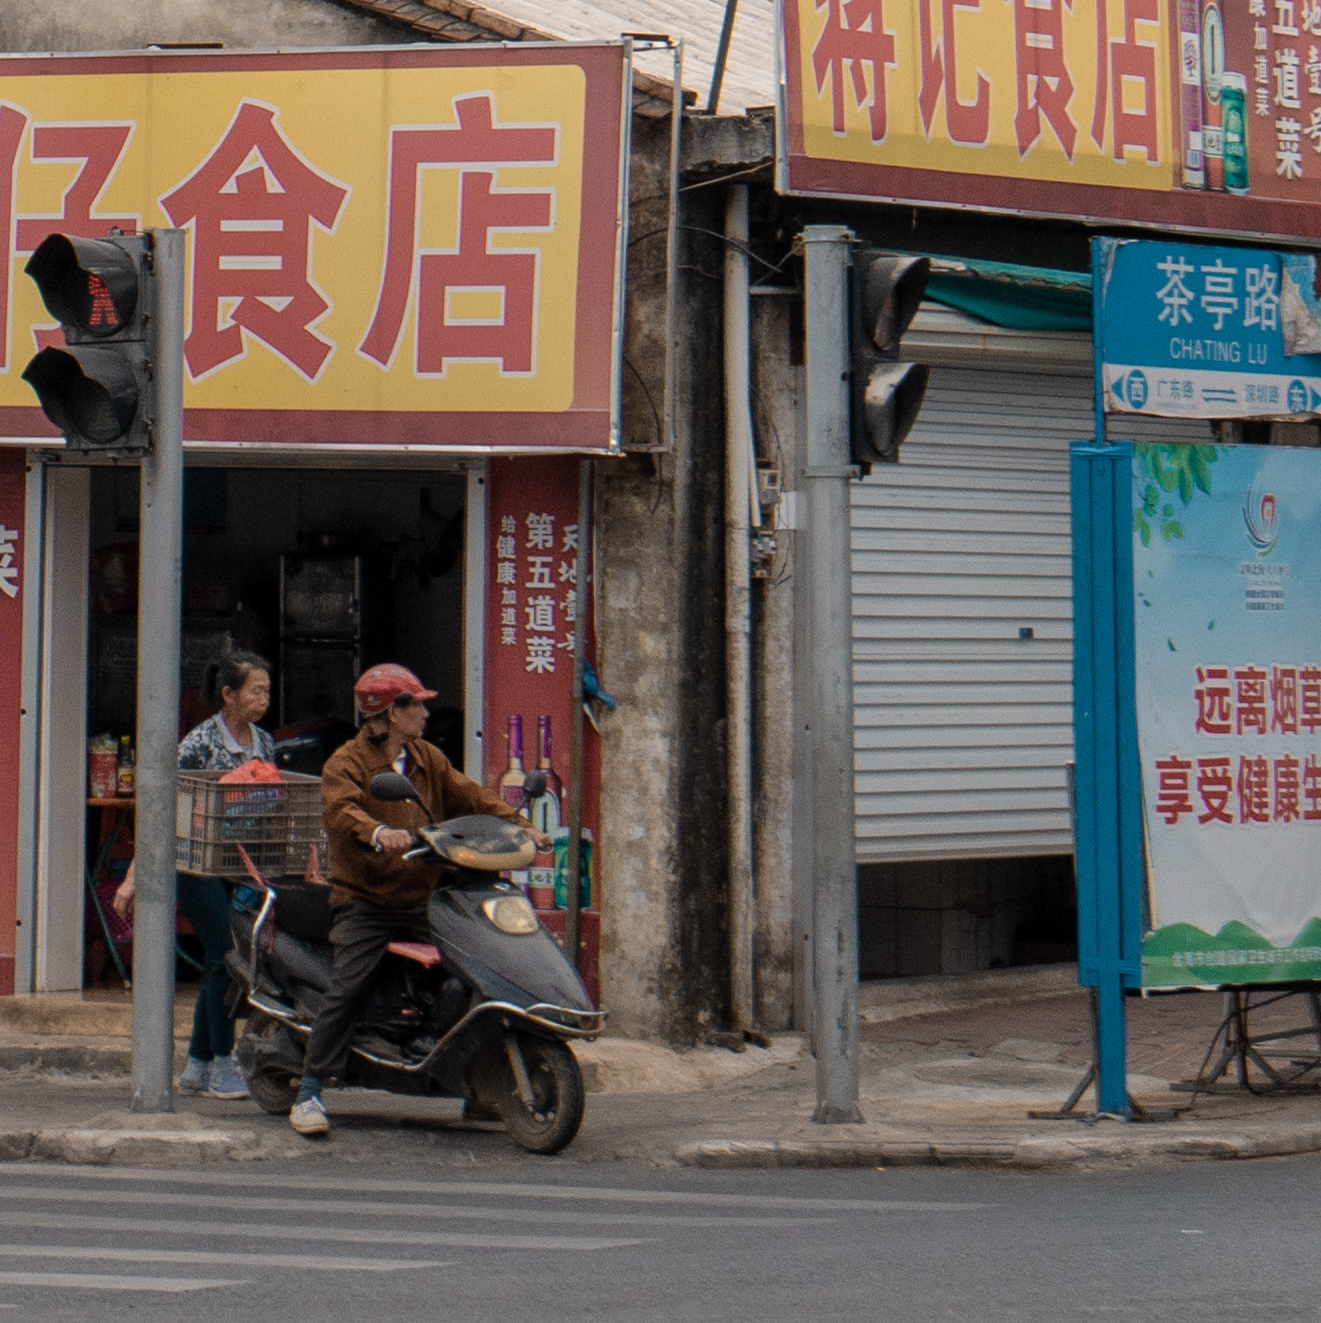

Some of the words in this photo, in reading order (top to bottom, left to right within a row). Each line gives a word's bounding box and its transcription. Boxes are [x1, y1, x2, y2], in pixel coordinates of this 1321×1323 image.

[1155, 255, 1280, 331] 茶亭路
[1169, 337, 1240, 363] CHATING
[1248, 342, 1267, 364] LU
[496, 515, 516, 645] 给健康加道菜
[525, 512, 556, 674] 第五道菜
